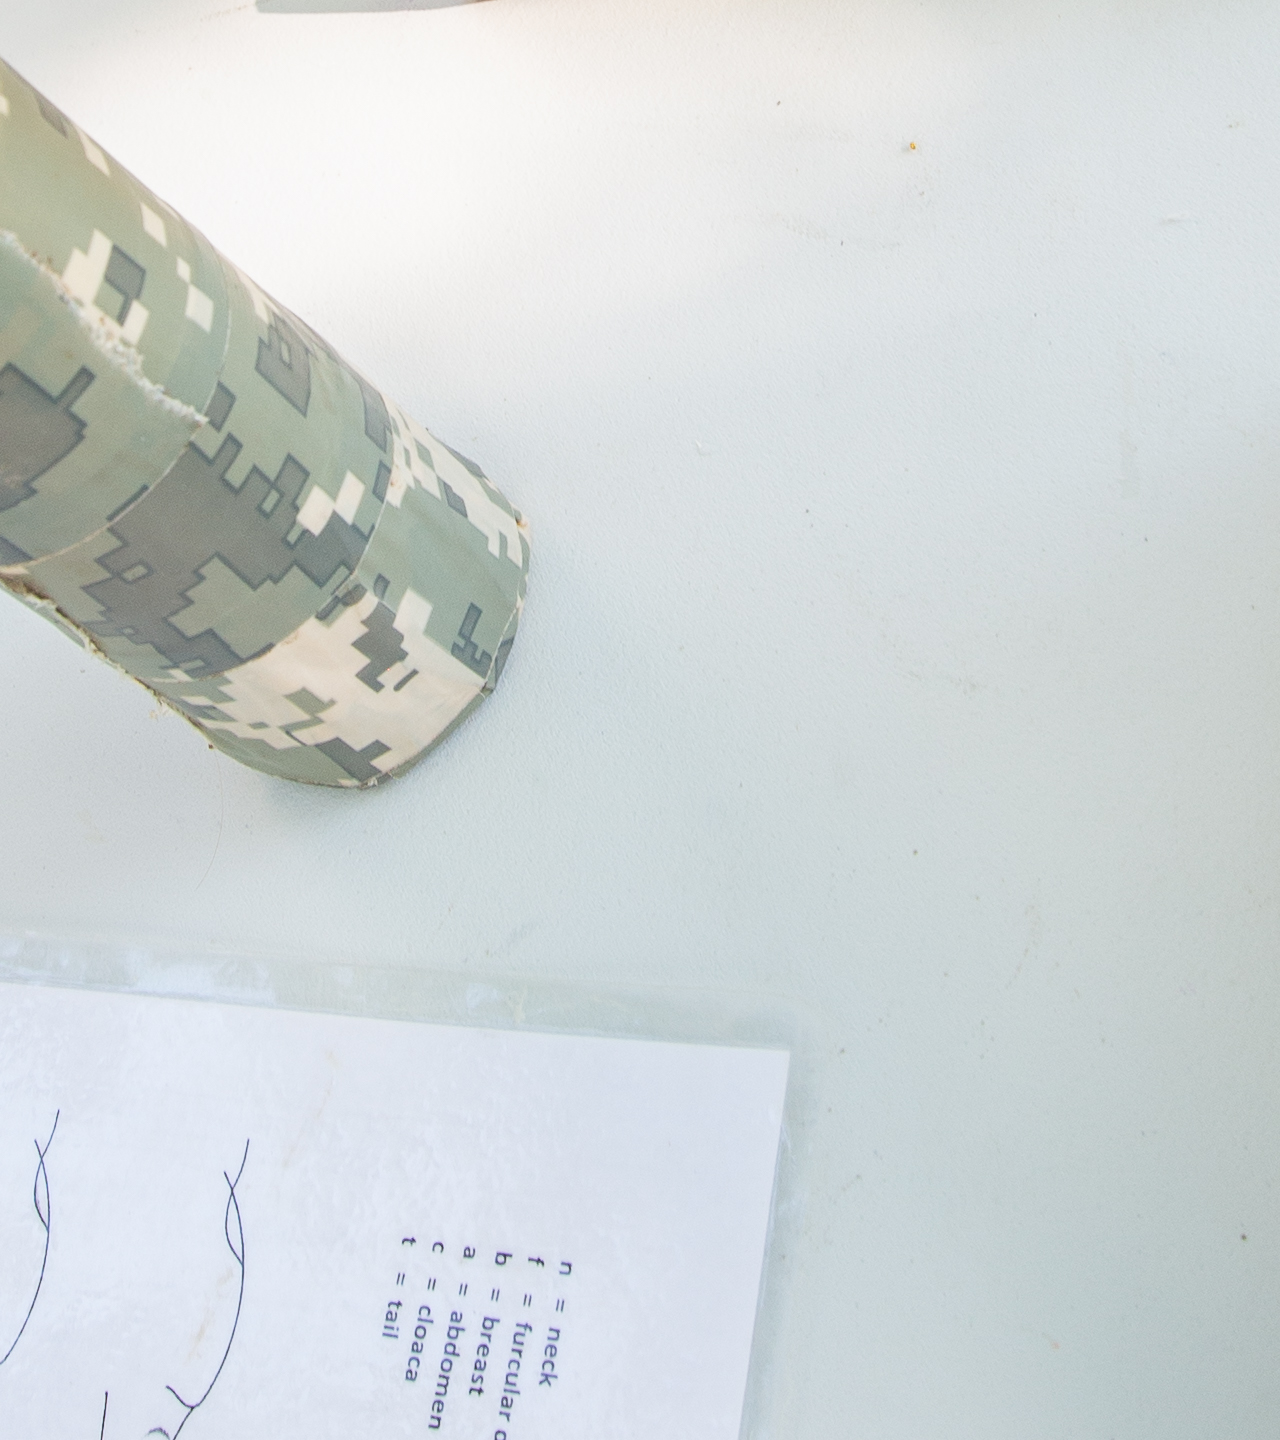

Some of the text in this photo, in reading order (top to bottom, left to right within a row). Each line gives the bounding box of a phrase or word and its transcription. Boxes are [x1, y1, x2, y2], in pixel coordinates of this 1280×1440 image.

[401, 1237, 417, 1246] t
[431, 1241, 445, 1253] c
[462, 1246, 476, 1260] a
[494, 1251, 514, 1267] b
[527, 1257, 545, 1267] f
[559, 1261, 573, 1276] n
[382, 1299, 404, 1340] tail
[404, 1305, 435, 1383] cloaca
[469, 1316, 500, 1396] breast
[538, 1327, 561, 1387] neck
[428, 1310, 465, 1430] abdomen
[498, 1322, 532, 1422] furcular
